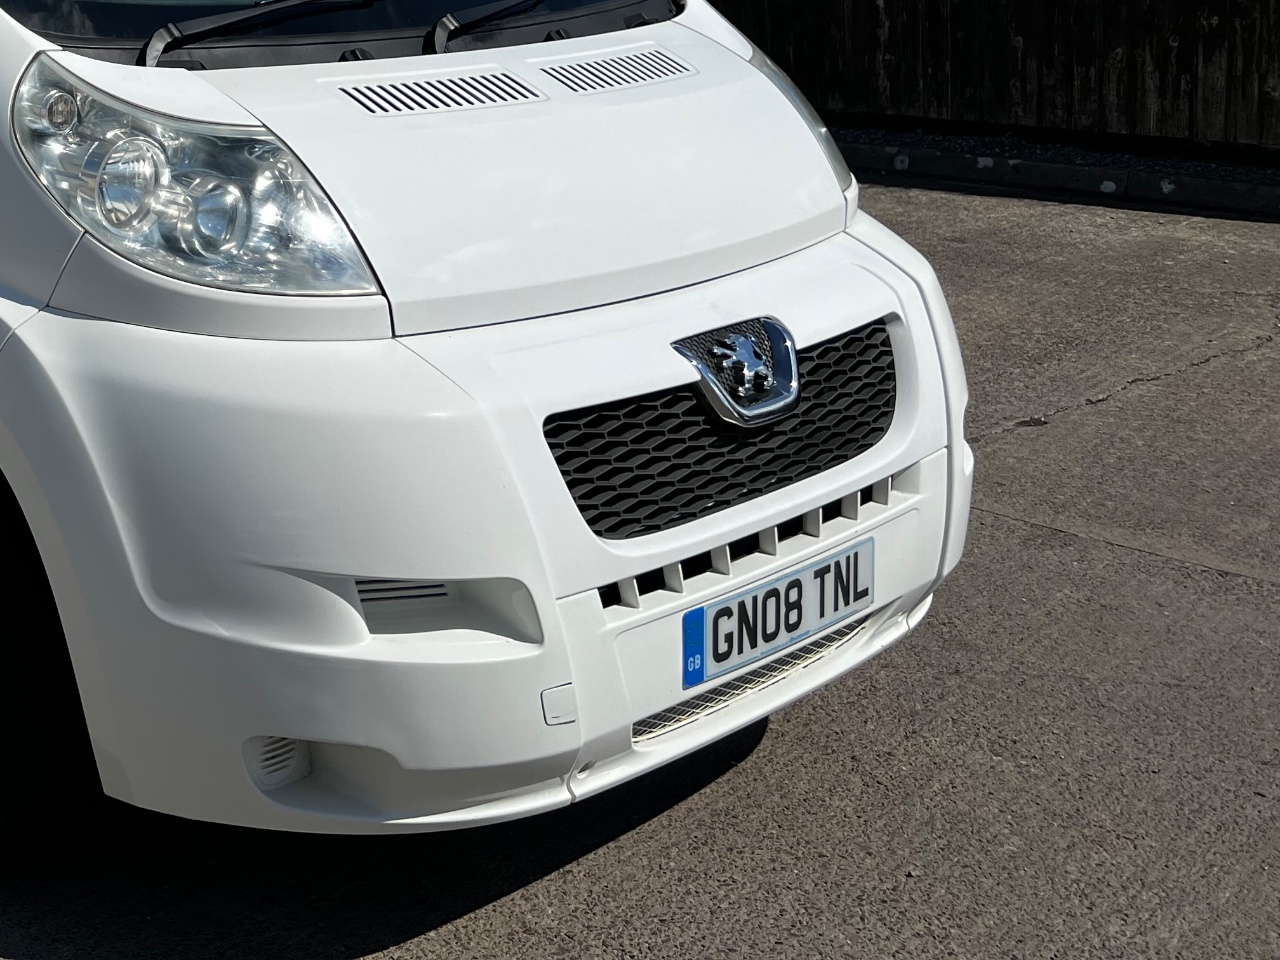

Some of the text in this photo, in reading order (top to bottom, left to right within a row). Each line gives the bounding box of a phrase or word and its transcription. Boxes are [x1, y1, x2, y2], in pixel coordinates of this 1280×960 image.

[712, 551, 870, 664] GN08 TNL
[687, 654, 701, 672] GB
